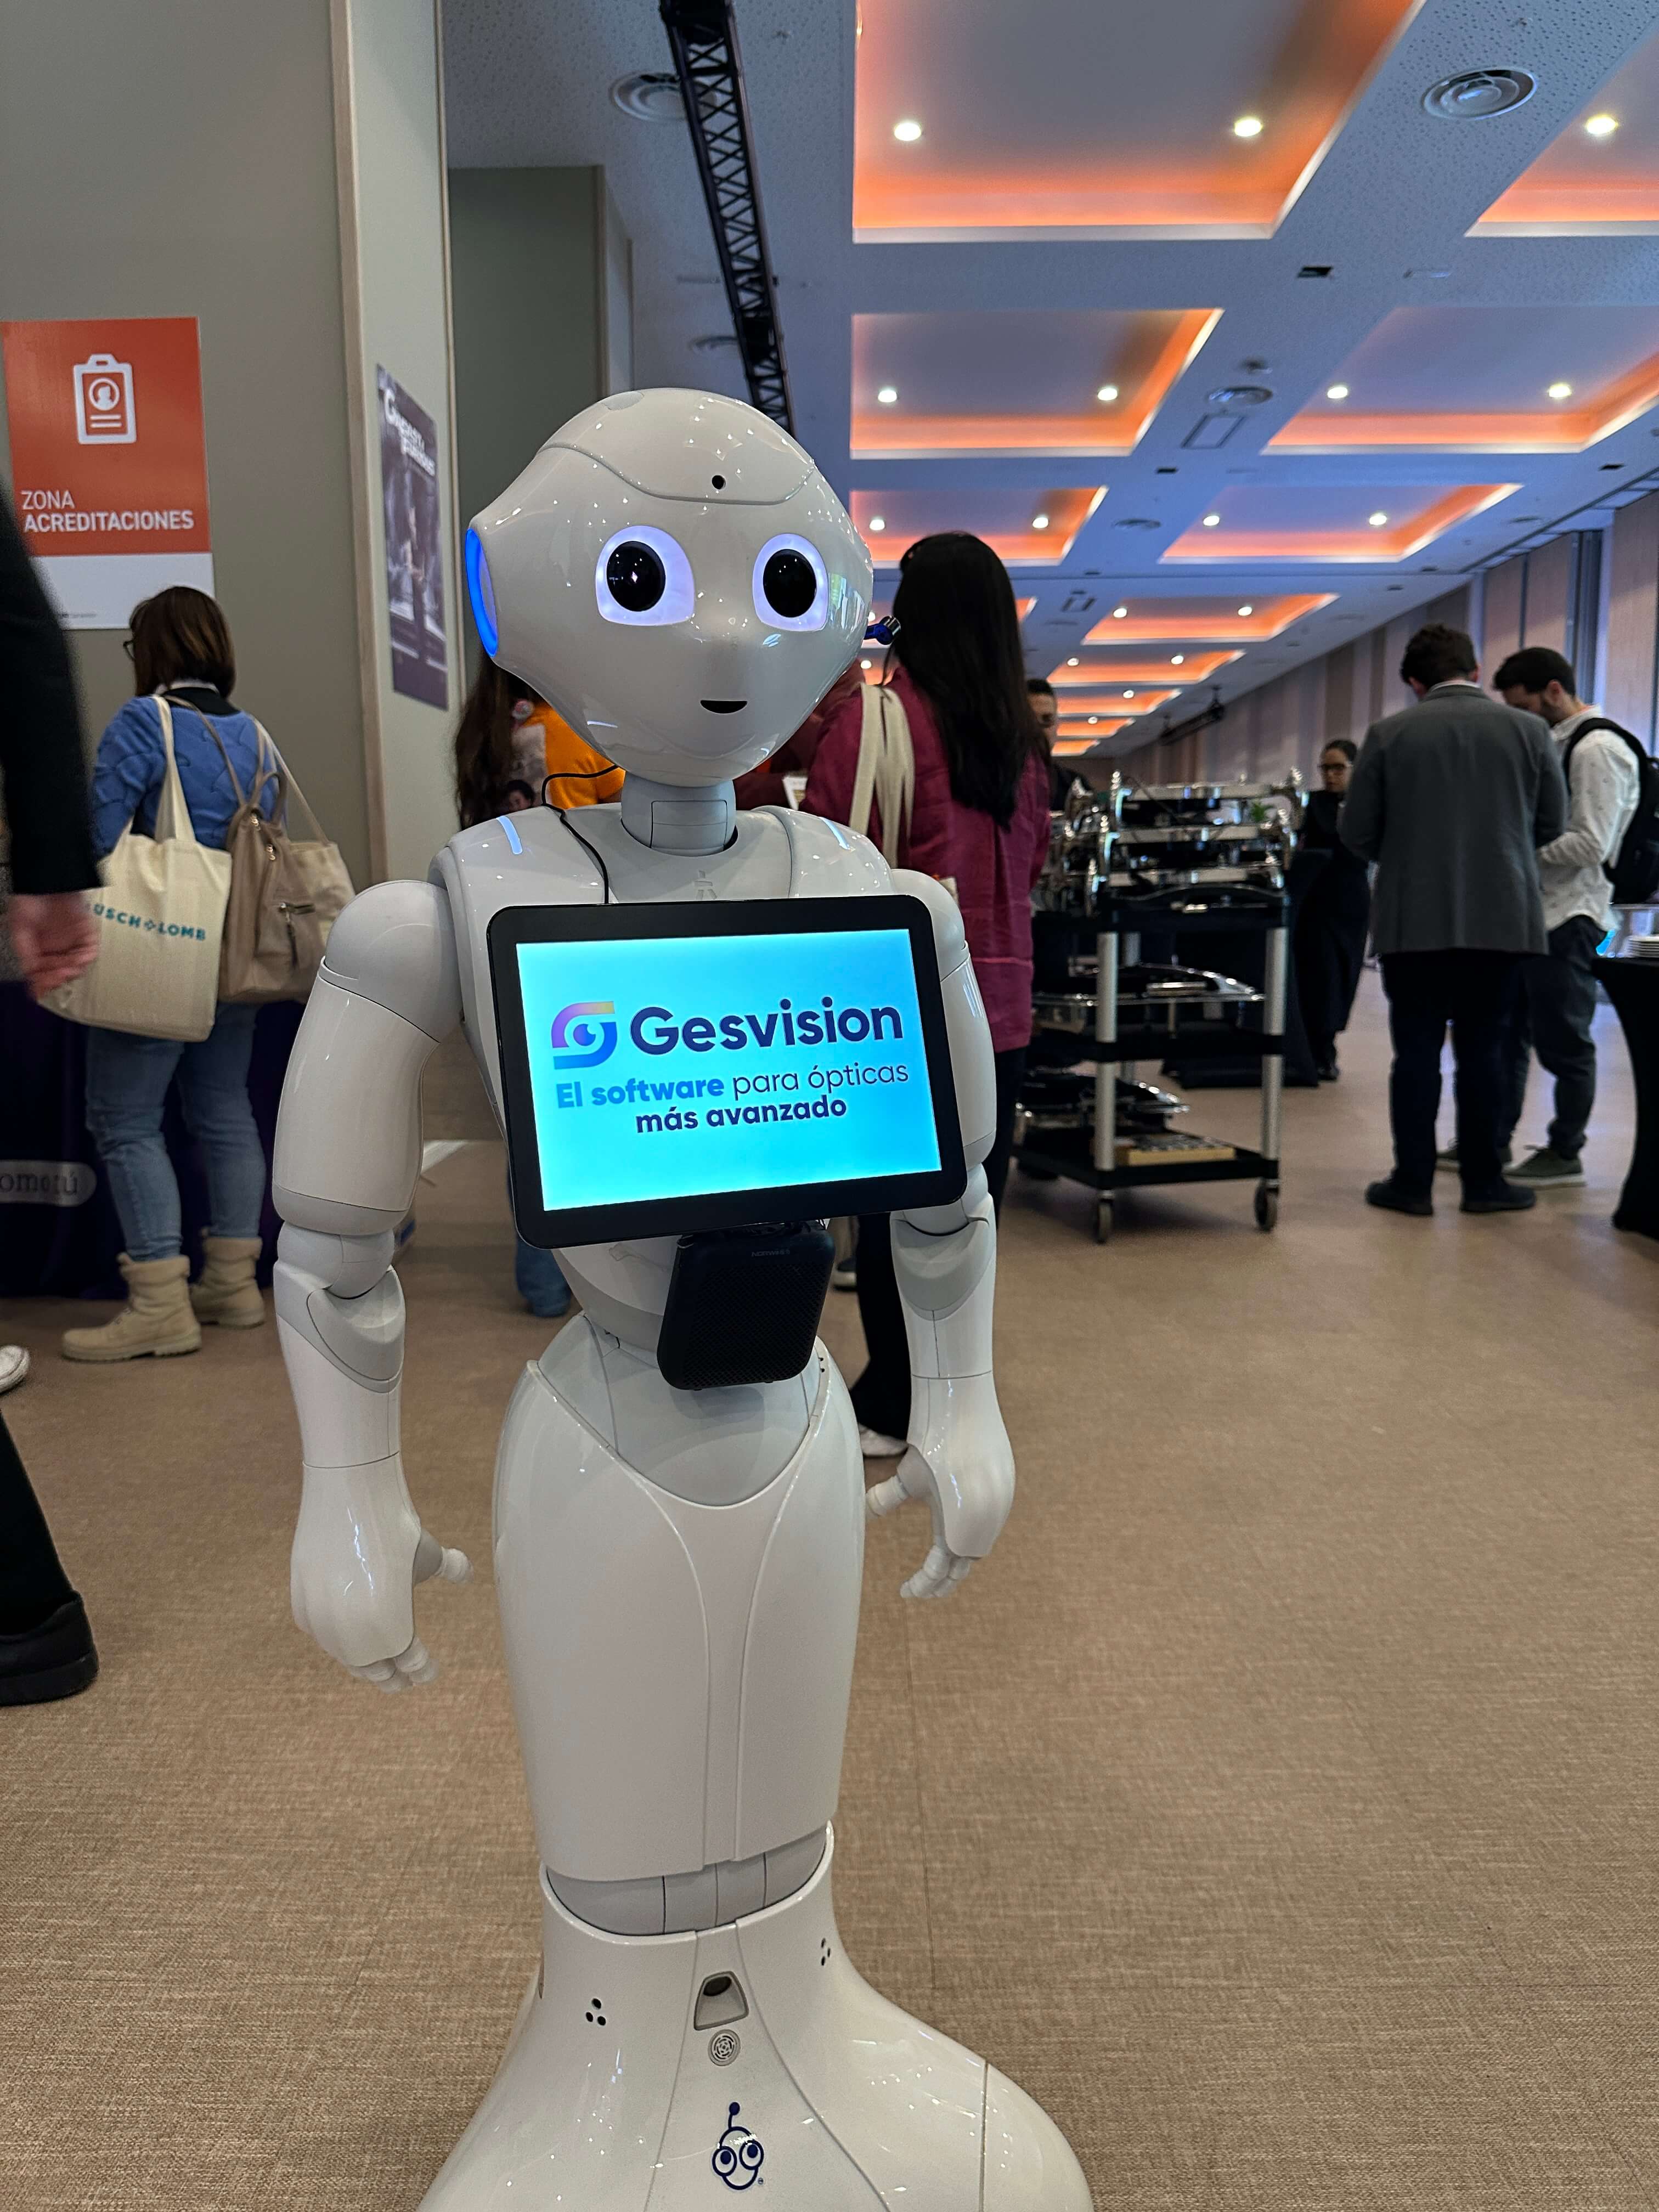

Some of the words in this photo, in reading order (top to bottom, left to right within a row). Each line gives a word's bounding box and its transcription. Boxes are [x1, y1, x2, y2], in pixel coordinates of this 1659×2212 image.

[21, 490, 76, 510] ZONA
[24, 509, 195, 533] ACREDITACIONES
[86, 903, 141, 928] USCH
[158, 922, 206, 941] LOMB
[630, 996, 903, 1055] Gesvision
[556, 1081, 583, 1108] El
[591, 1077, 725, 1106] software
[732, 1073, 799, 1101] para
[808, 1062, 909, 1094] ópticas
[635, 1106, 698, 1133] más
[706, 1094, 847, 1128] avanzado
